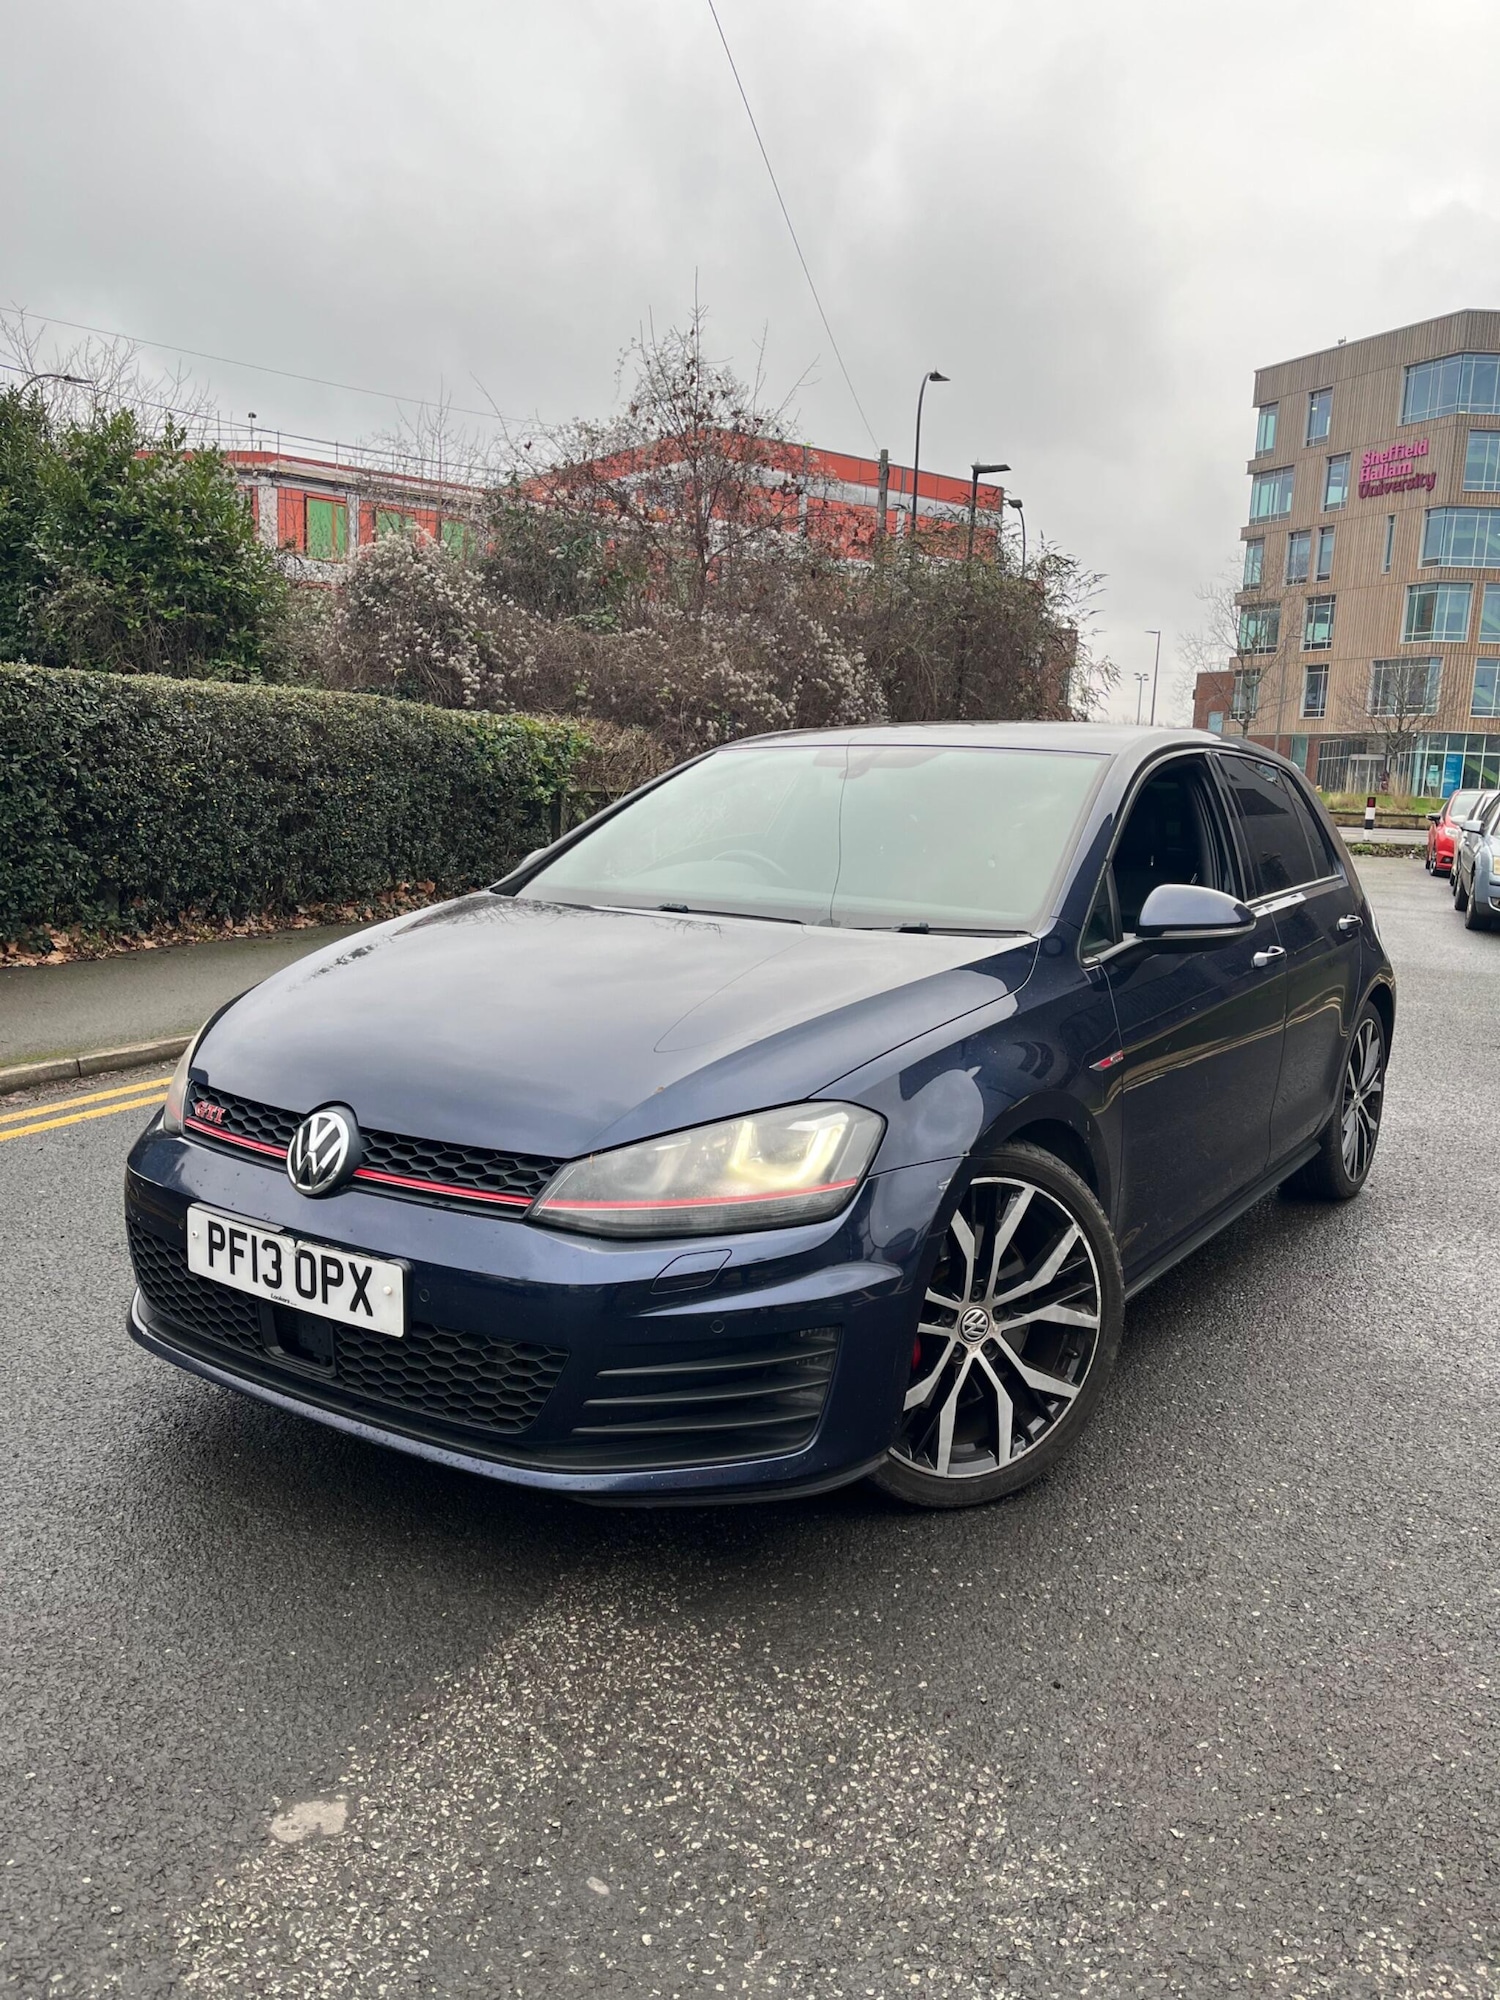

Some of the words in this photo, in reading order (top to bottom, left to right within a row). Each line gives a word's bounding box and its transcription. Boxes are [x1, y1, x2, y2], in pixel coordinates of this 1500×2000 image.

[1362, 438, 1429, 467] Sheffield
[1358, 472, 1436, 499] University
[1360, 462, 1413, 482] Hallam
[194, 1100, 226, 1125] GTI
[208, 1220, 282, 1289] PF13
[295, 1250, 374, 1317] OPX
